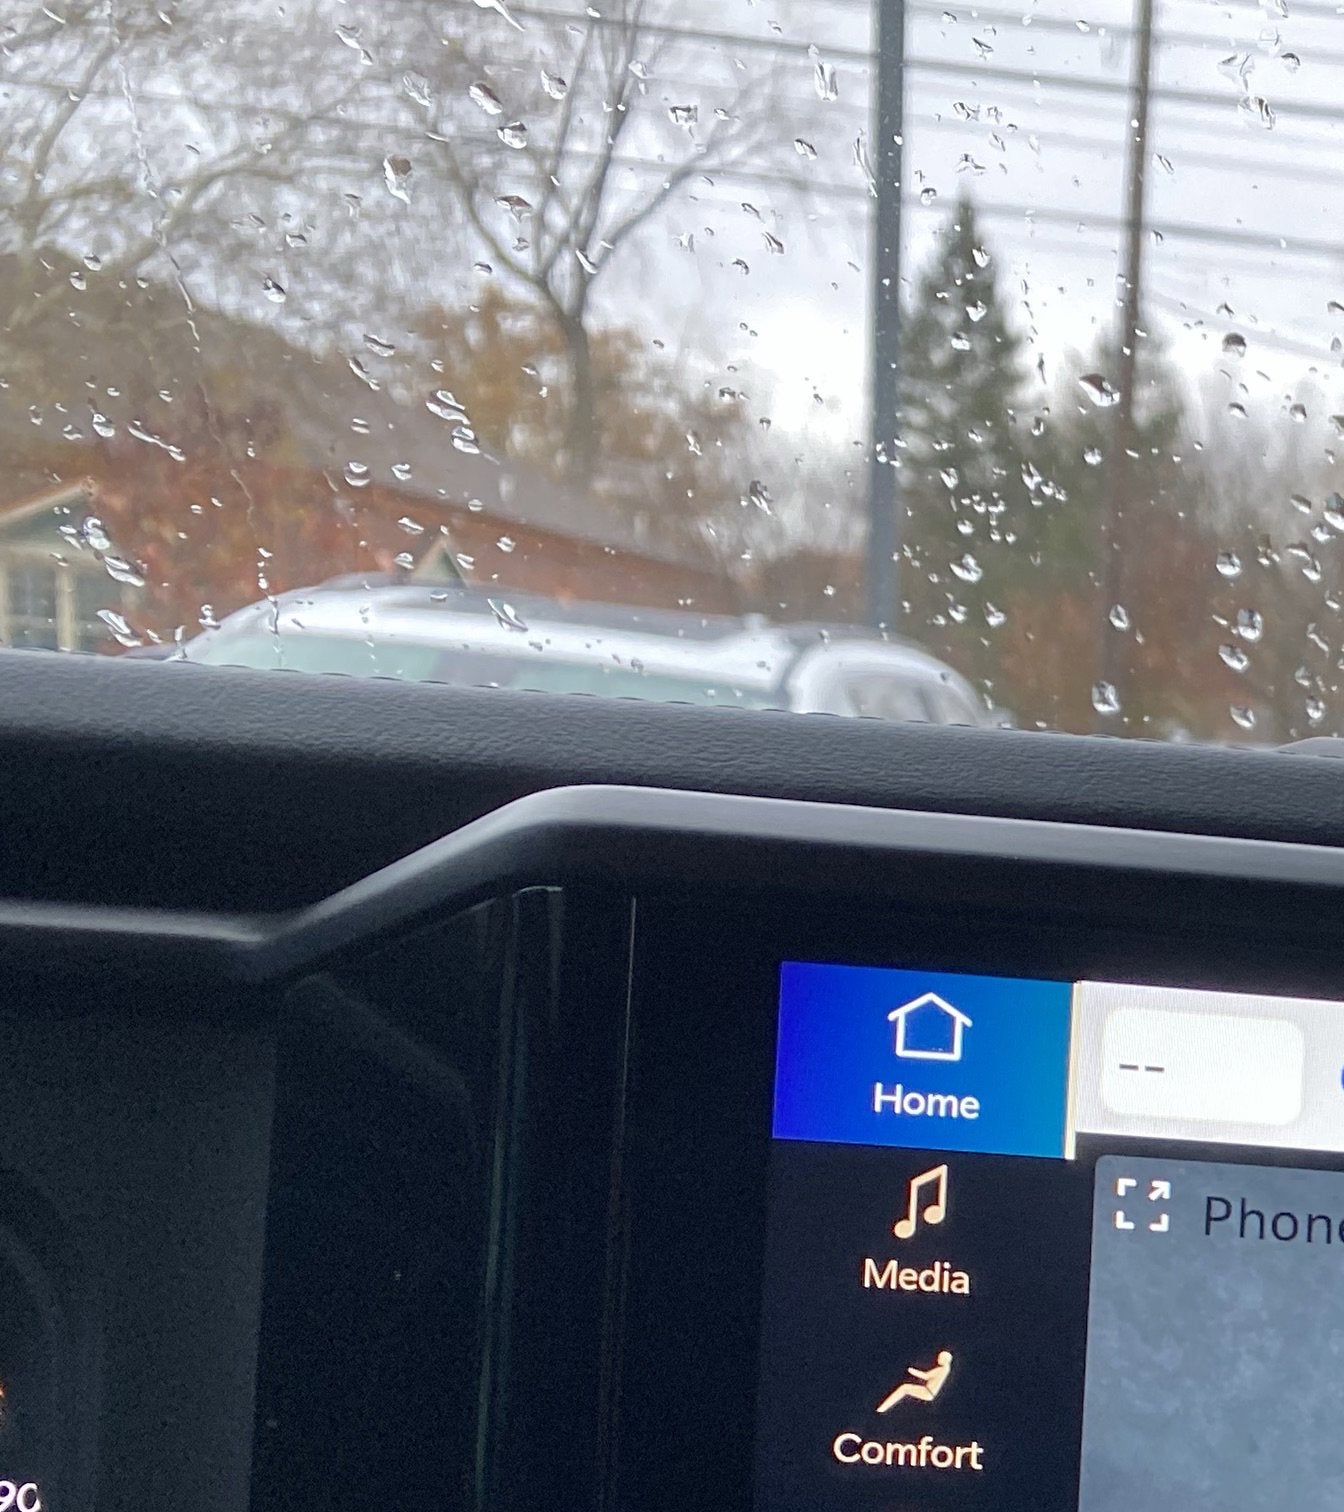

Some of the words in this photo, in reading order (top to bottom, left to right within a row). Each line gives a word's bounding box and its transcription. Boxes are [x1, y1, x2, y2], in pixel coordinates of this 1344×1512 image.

[873, 1082, 980, 1119] Home
[863, 1258, 970, 1294] Media
[833, 1432, 984, 1470] Comfort
